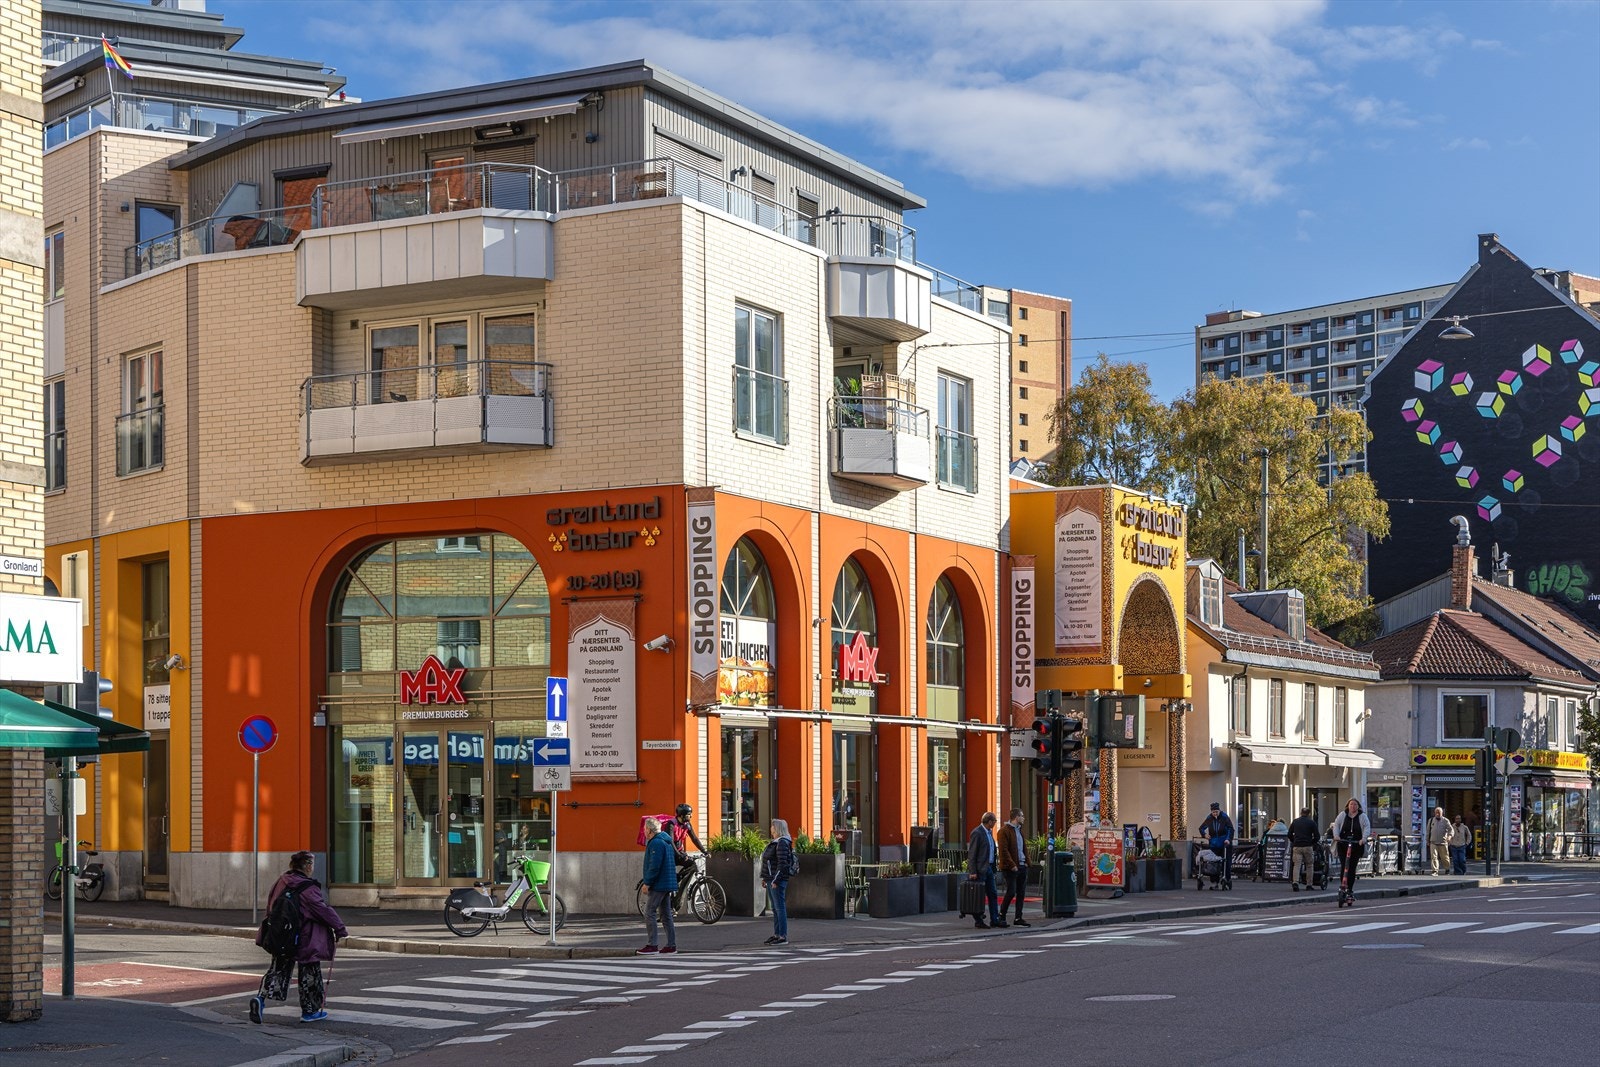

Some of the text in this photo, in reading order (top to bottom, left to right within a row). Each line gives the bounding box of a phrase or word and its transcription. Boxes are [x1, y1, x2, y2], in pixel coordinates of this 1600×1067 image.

[692, 515, 714, 655] SHOPPING
[0, 618, 59, 655] MA
[721, 621, 734, 640] ET!
[1015, 578, 1031, 689] SHOPPING
[579, 645, 624, 653] PÅ GRØNLAND
[735, 642, 770, 662] HICKEN
[839, 630, 879, 683] MAX
[400, 655, 468, 706] MAX
[148, 694, 155, 704] 78
[402, 709, 470, 720] PREMIUM BURGERS
